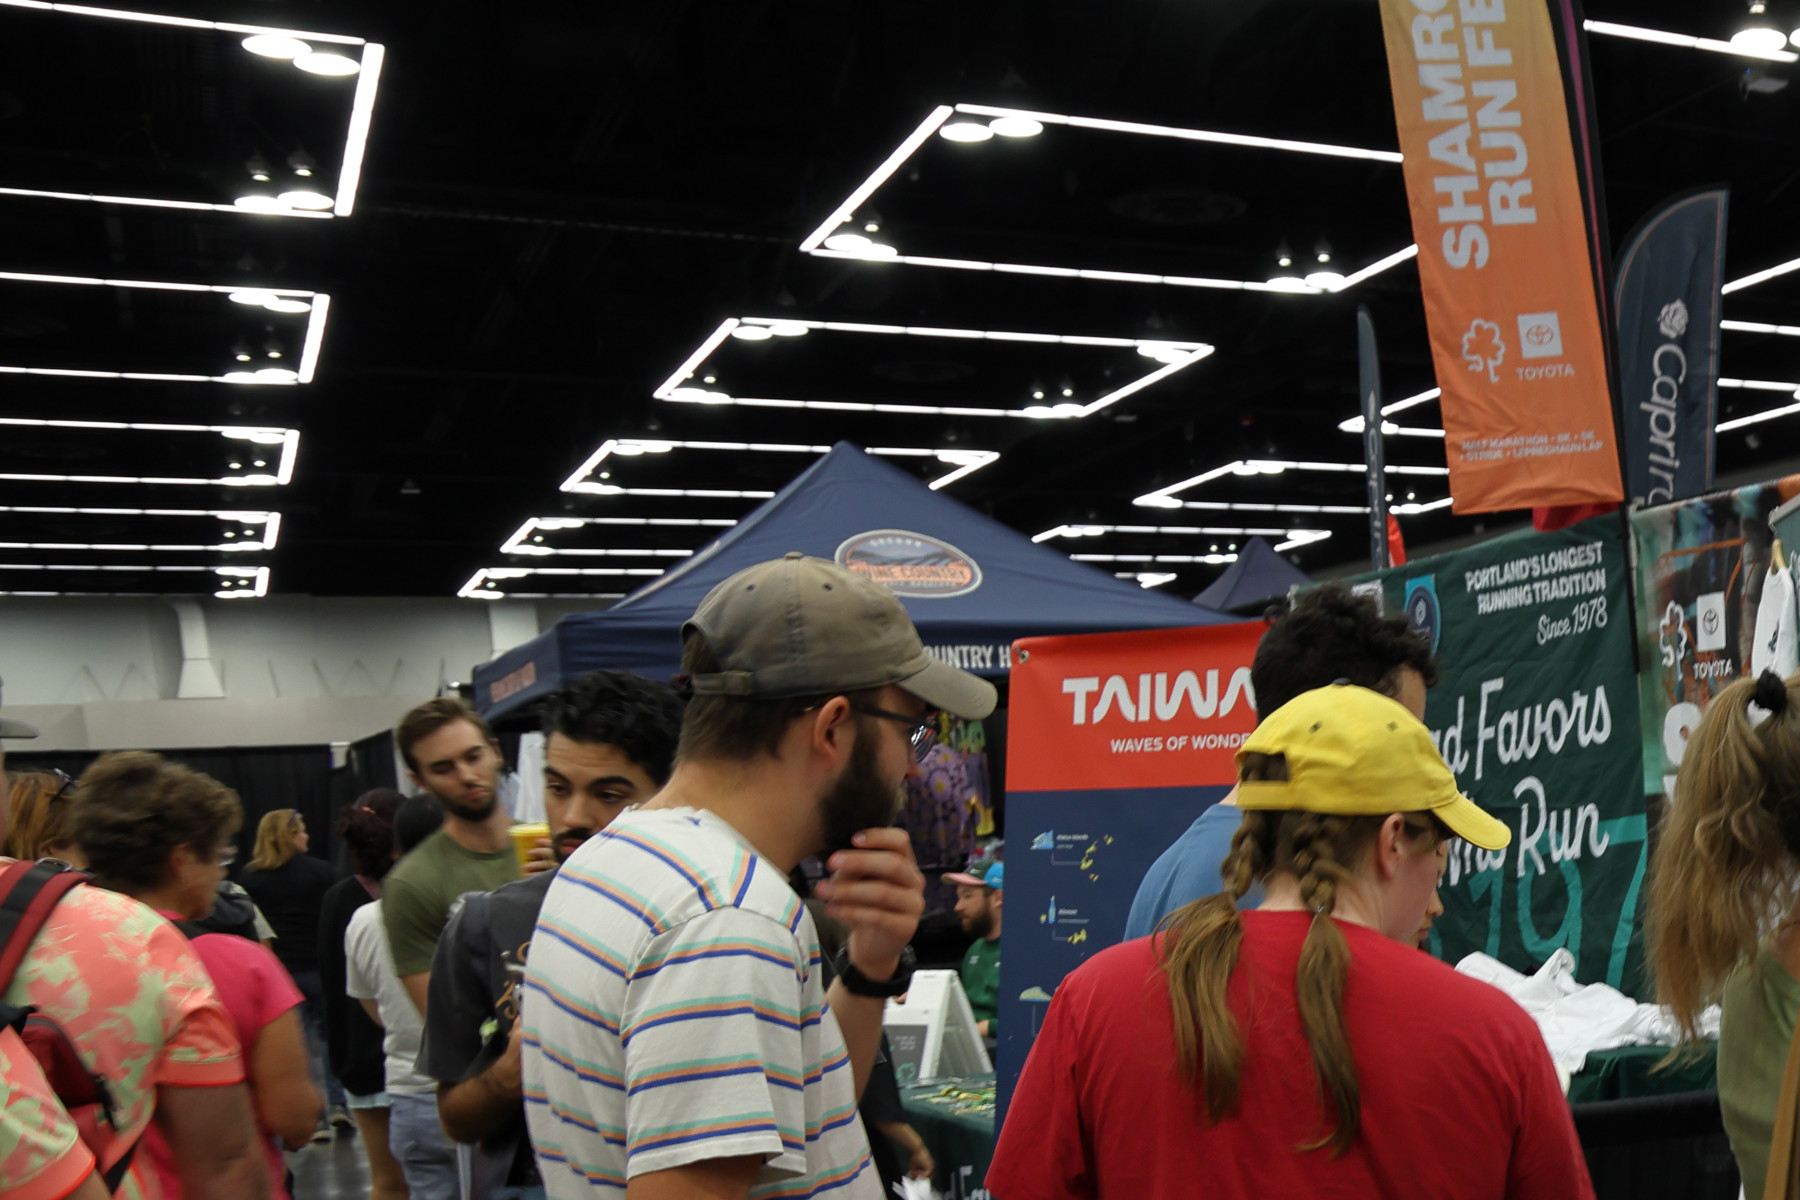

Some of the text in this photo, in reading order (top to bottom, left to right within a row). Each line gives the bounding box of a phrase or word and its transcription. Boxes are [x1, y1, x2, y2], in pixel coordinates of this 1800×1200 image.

[1410, 0, 1490, 270] SHAMR
[1471, 79, 1537, 226] RUN
[1515, 363, 1576, 382] TOYOTA
[1489, 433, 1549, 449] MARATHON
[1464, 540, 1604, 593] PORTLAND'S LONGEST
[1476, 567, 1607, 615] RUNNING TRADITION
[1536, 594, 1609, 646] Since 1978
[923, 644, 994, 669] OUNTRY
[1692, 658, 1733, 681] TOYOTA
[1061, 665, 1259, 726] TAIWA
[1110, 732, 1250, 754] WAVES OF WONDE
[1474, 676, 1612, 781] Favors
[1513, 775, 1610, 879] Run
